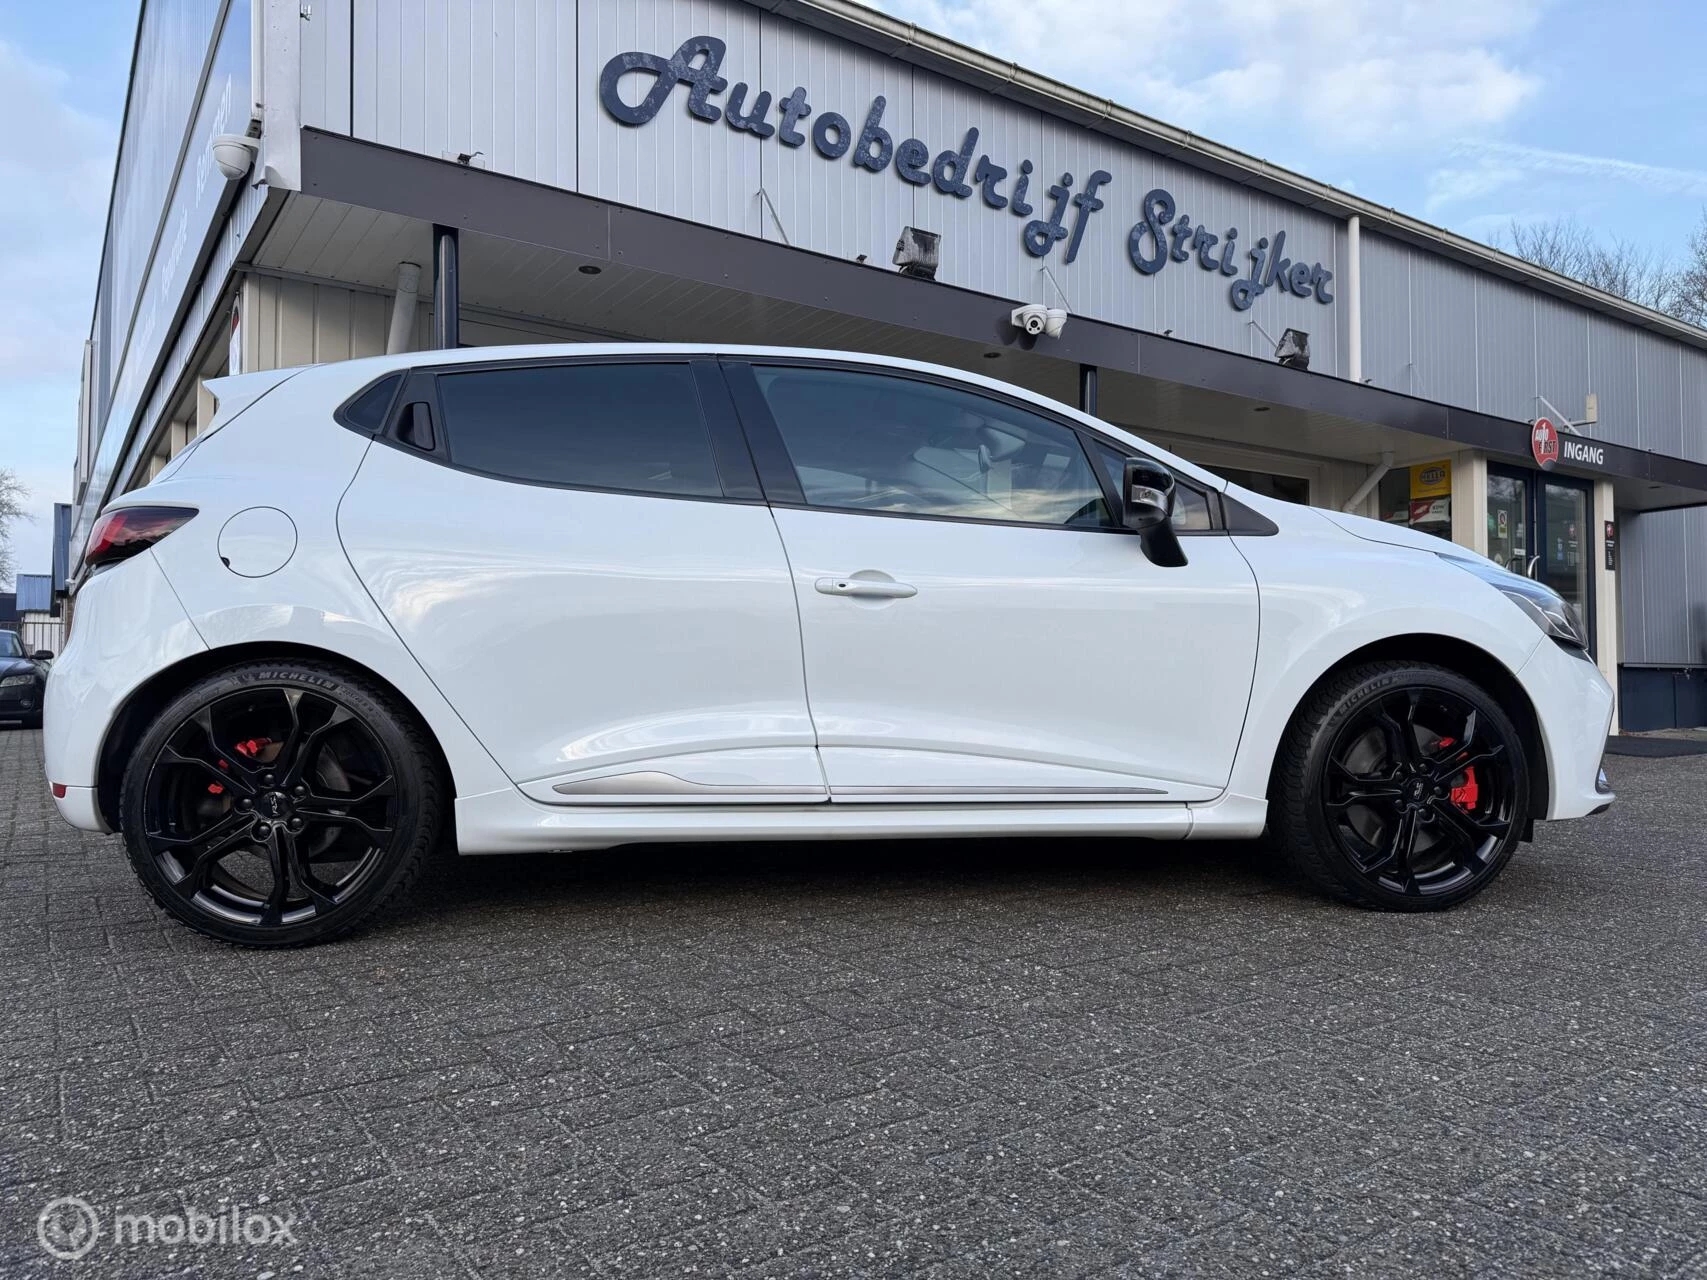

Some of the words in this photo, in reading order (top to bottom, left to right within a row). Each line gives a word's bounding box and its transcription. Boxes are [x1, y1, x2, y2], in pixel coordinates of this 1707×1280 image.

[600, 35, 1112, 264] Autobedrijf
[1129, 188, 1334, 310] Strijker
[1563, 440, 1604, 465] INGANG
[258, 670, 335, 689] MICHELIN
[1339, 677, 1391, 715] MICHELIN
